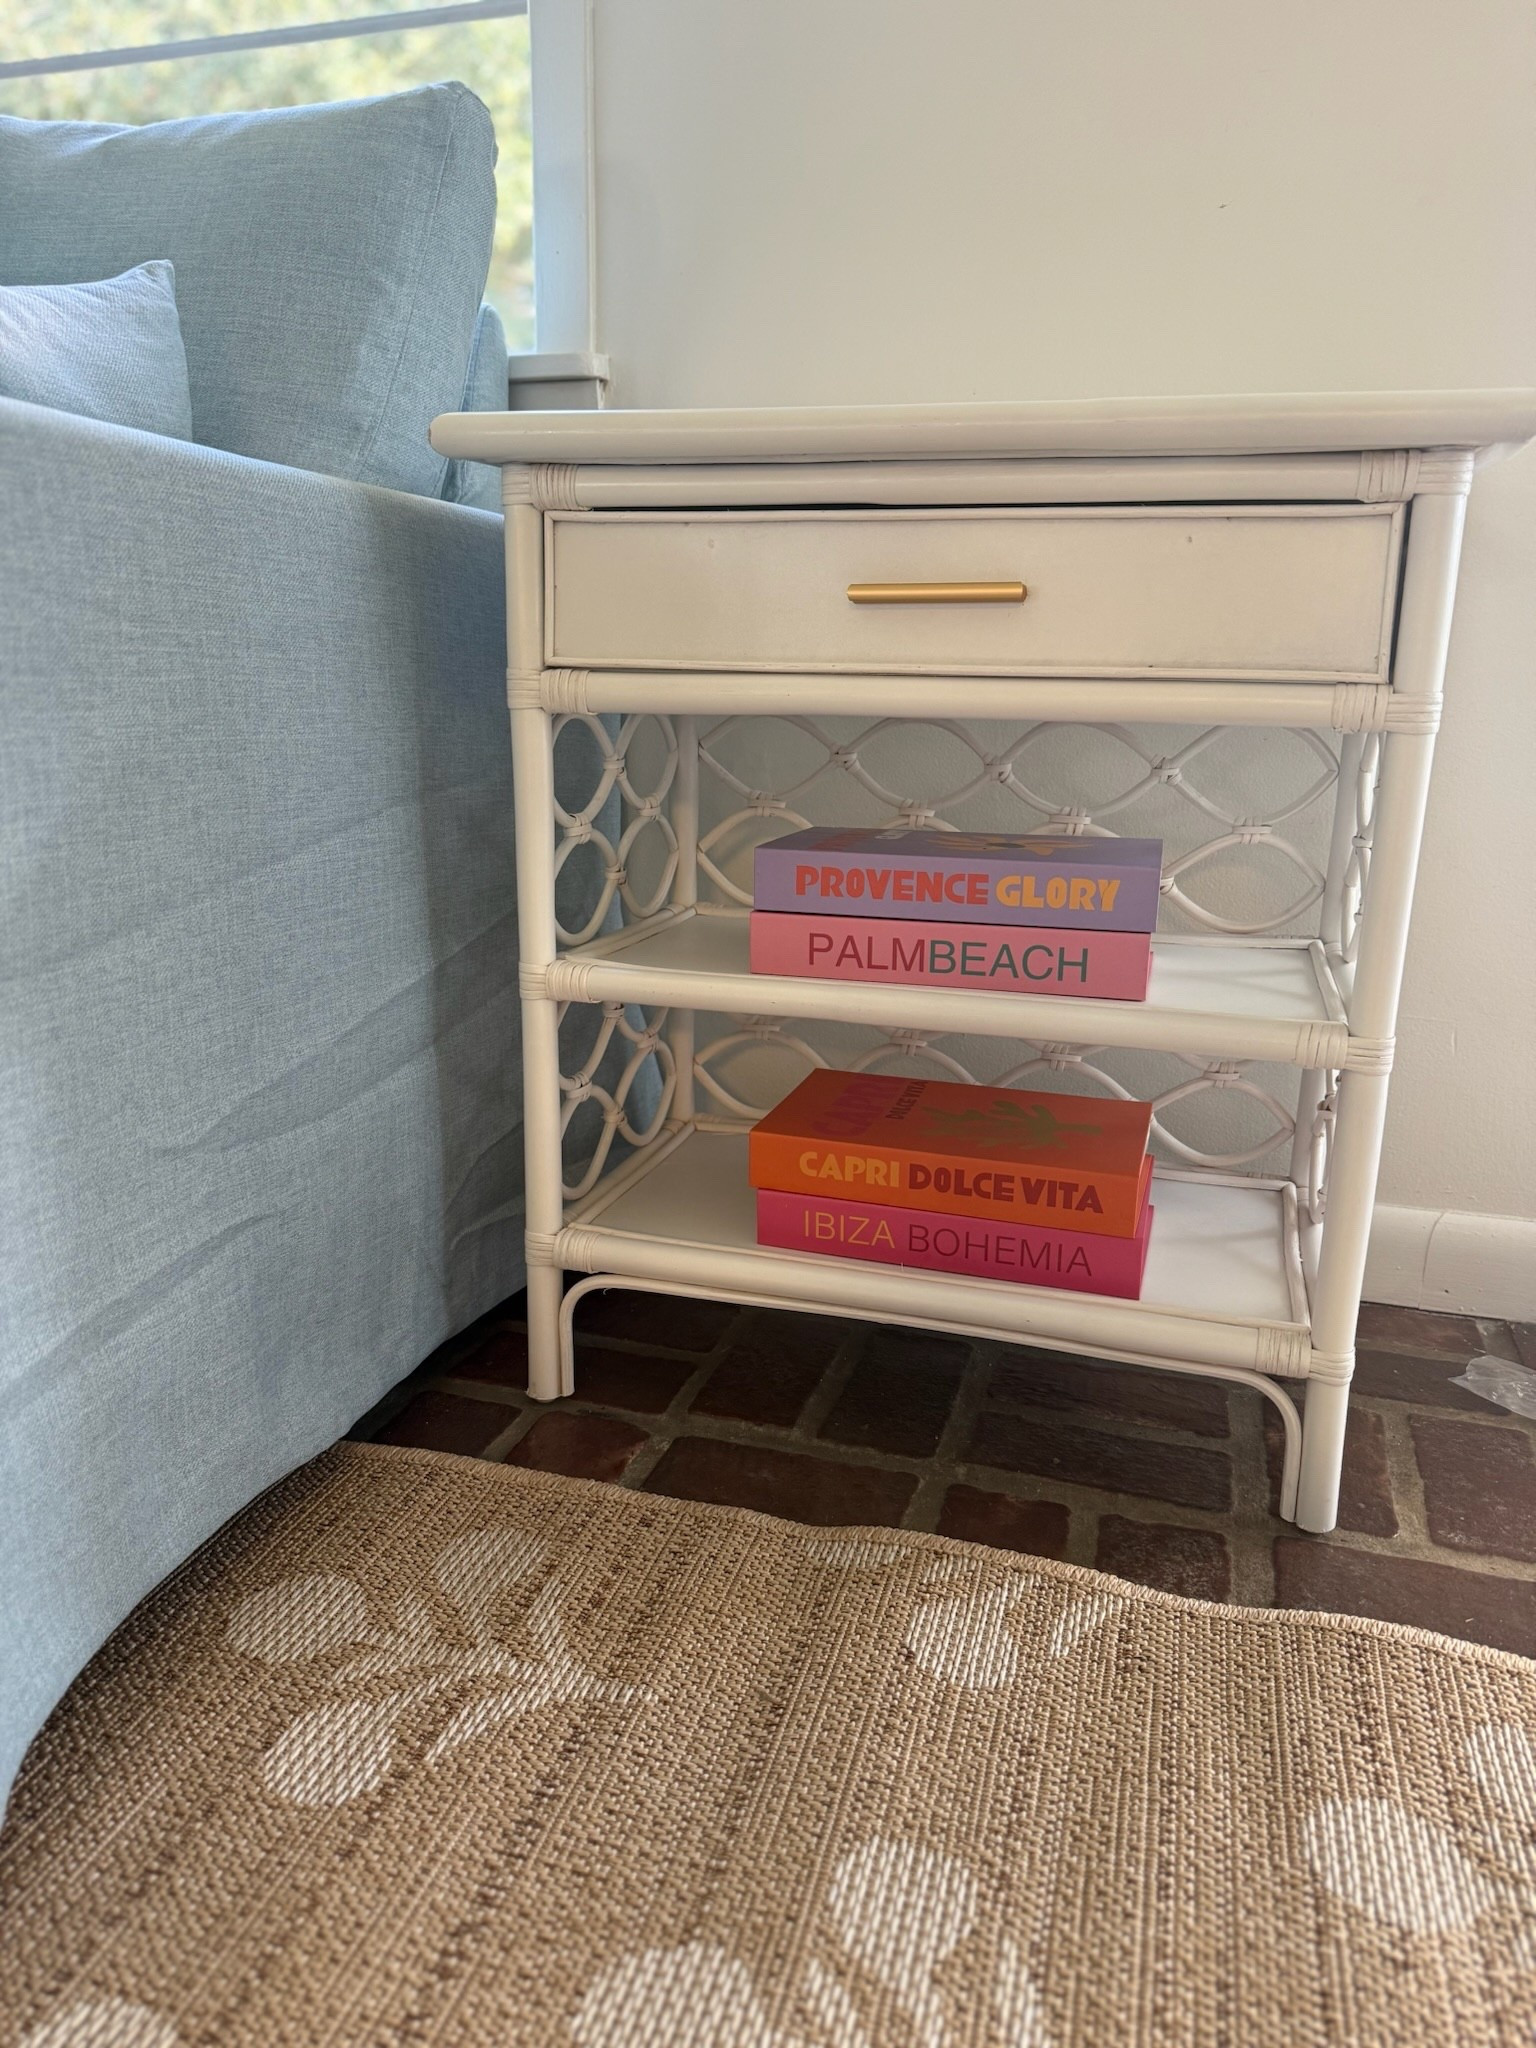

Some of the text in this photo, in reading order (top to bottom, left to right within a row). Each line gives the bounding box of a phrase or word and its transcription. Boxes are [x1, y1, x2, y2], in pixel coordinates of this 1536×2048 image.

[795, 865, 1120, 912] PROVENCE GLORY
[800, 1151, 1103, 1213] CAPRI DOLCE VITA
[804, 1210, 1092, 1276] IBIZA BOHEMIA
